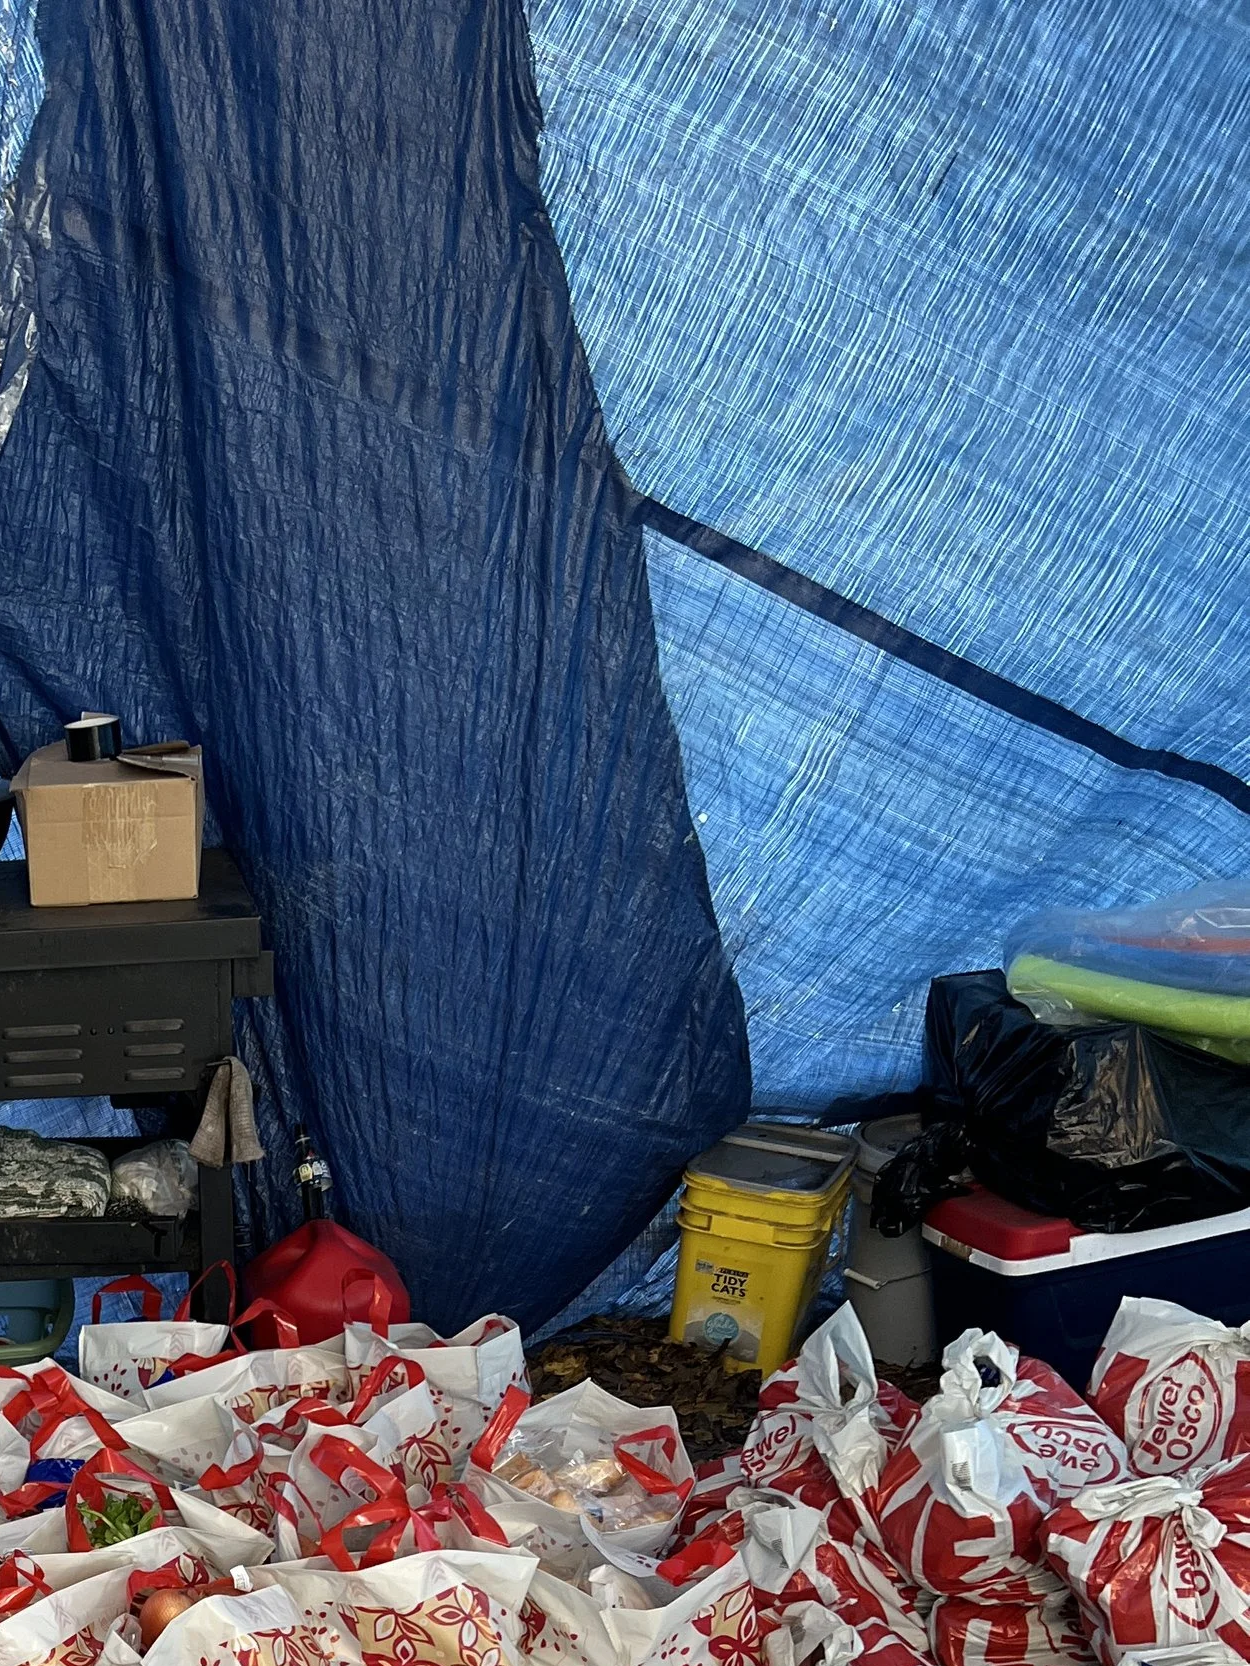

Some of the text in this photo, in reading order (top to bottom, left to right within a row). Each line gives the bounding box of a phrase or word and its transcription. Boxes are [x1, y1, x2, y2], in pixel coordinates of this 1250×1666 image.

[711, 1283, 746, 1297] CATS
[713, 1273, 747, 1287] TIDY
[741, 1414, 797, 1462] ewel
[1138, 1376, 1183, 1465] Jewel
[1166, 1385, 1205, 1460] Osco
[1039, 1444, 1100, 1472] ewe
